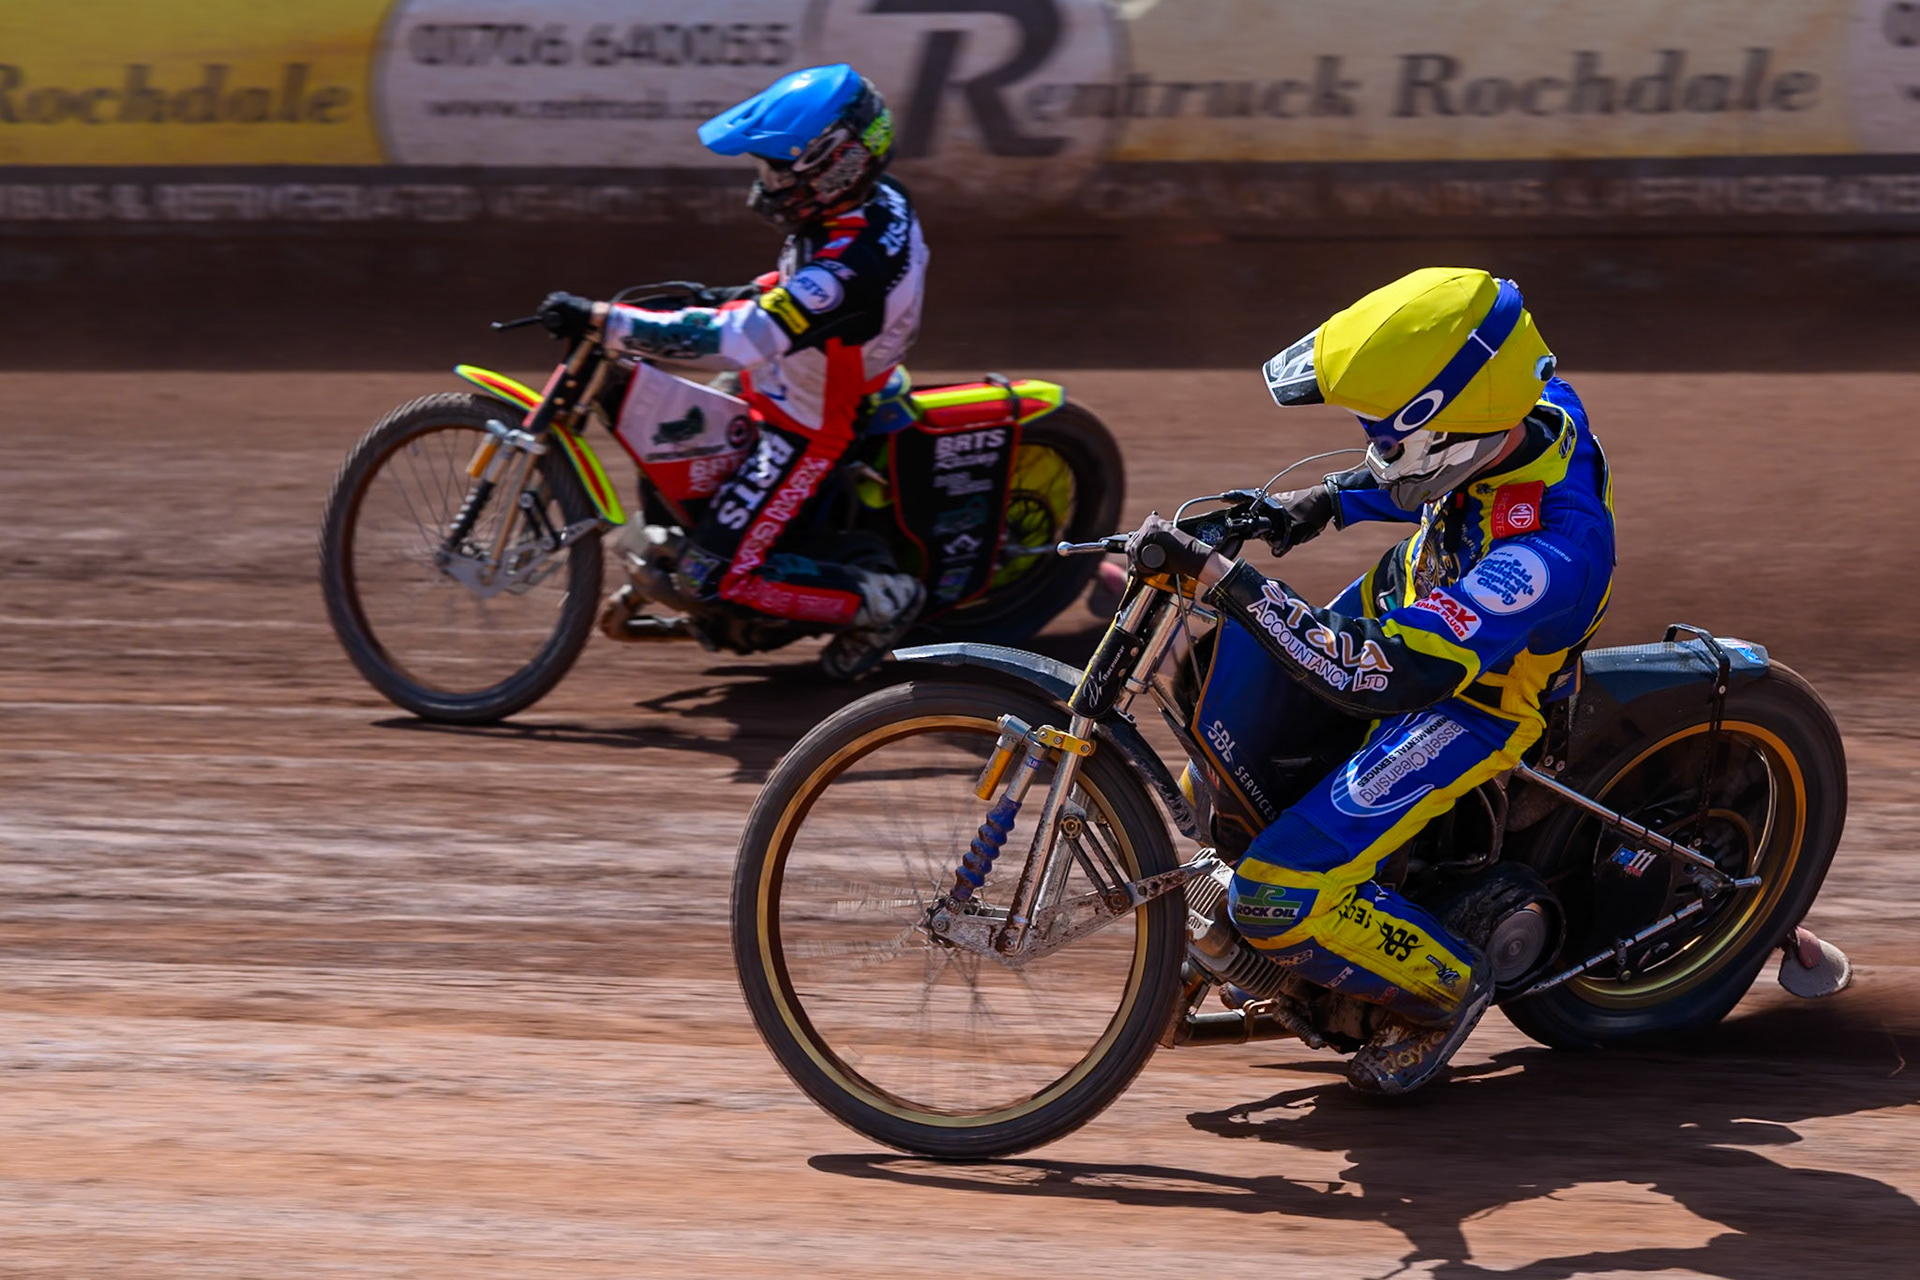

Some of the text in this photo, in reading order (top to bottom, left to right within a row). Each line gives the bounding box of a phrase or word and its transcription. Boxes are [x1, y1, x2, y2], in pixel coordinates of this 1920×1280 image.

[1387, 47, 1820, 119] Rochdale
[1415, 601, 1442, 613] SPARK
[1476, 576, 1517, 605] Charity
[1246, 598, 1353, 690] ACCOUNTANCY
[1356, 716, 1450, 789] VIRONMENTAL SERVICES
[1359, 722, 1463, 804] assett Cleansing
[1234, 764, 1278, 821] SERVICES
[1236, 904, 1297, 919] ROCK OIL
